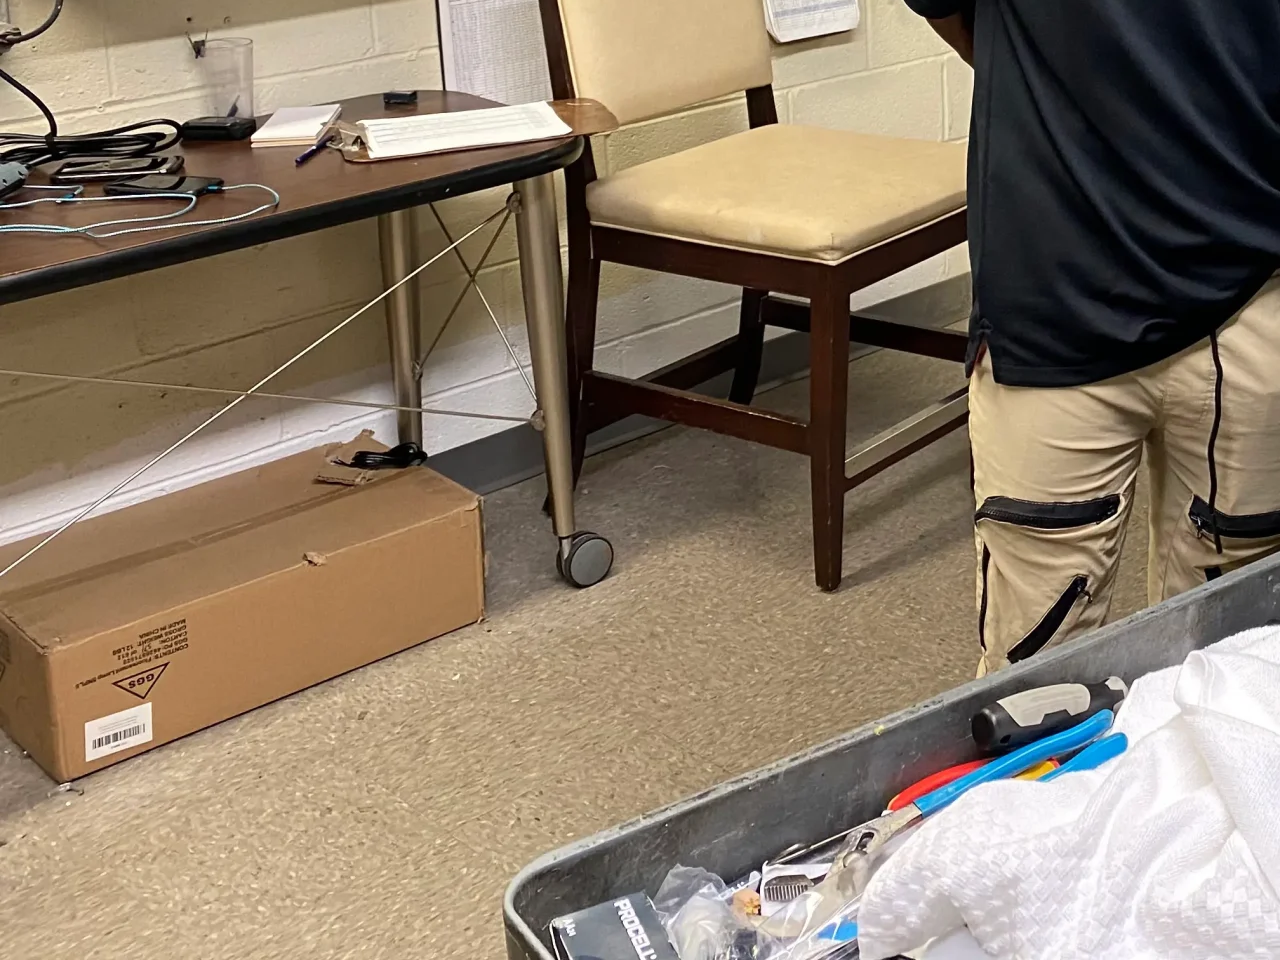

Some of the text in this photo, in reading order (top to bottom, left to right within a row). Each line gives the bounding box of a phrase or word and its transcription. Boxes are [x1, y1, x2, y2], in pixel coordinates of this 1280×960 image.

[168, 618, 186, 630] MADE
[138, 628, 160, 639] CHINA
[128, 673, 155, 689] GGS
[613, 898, 656, 960] PROCELL
